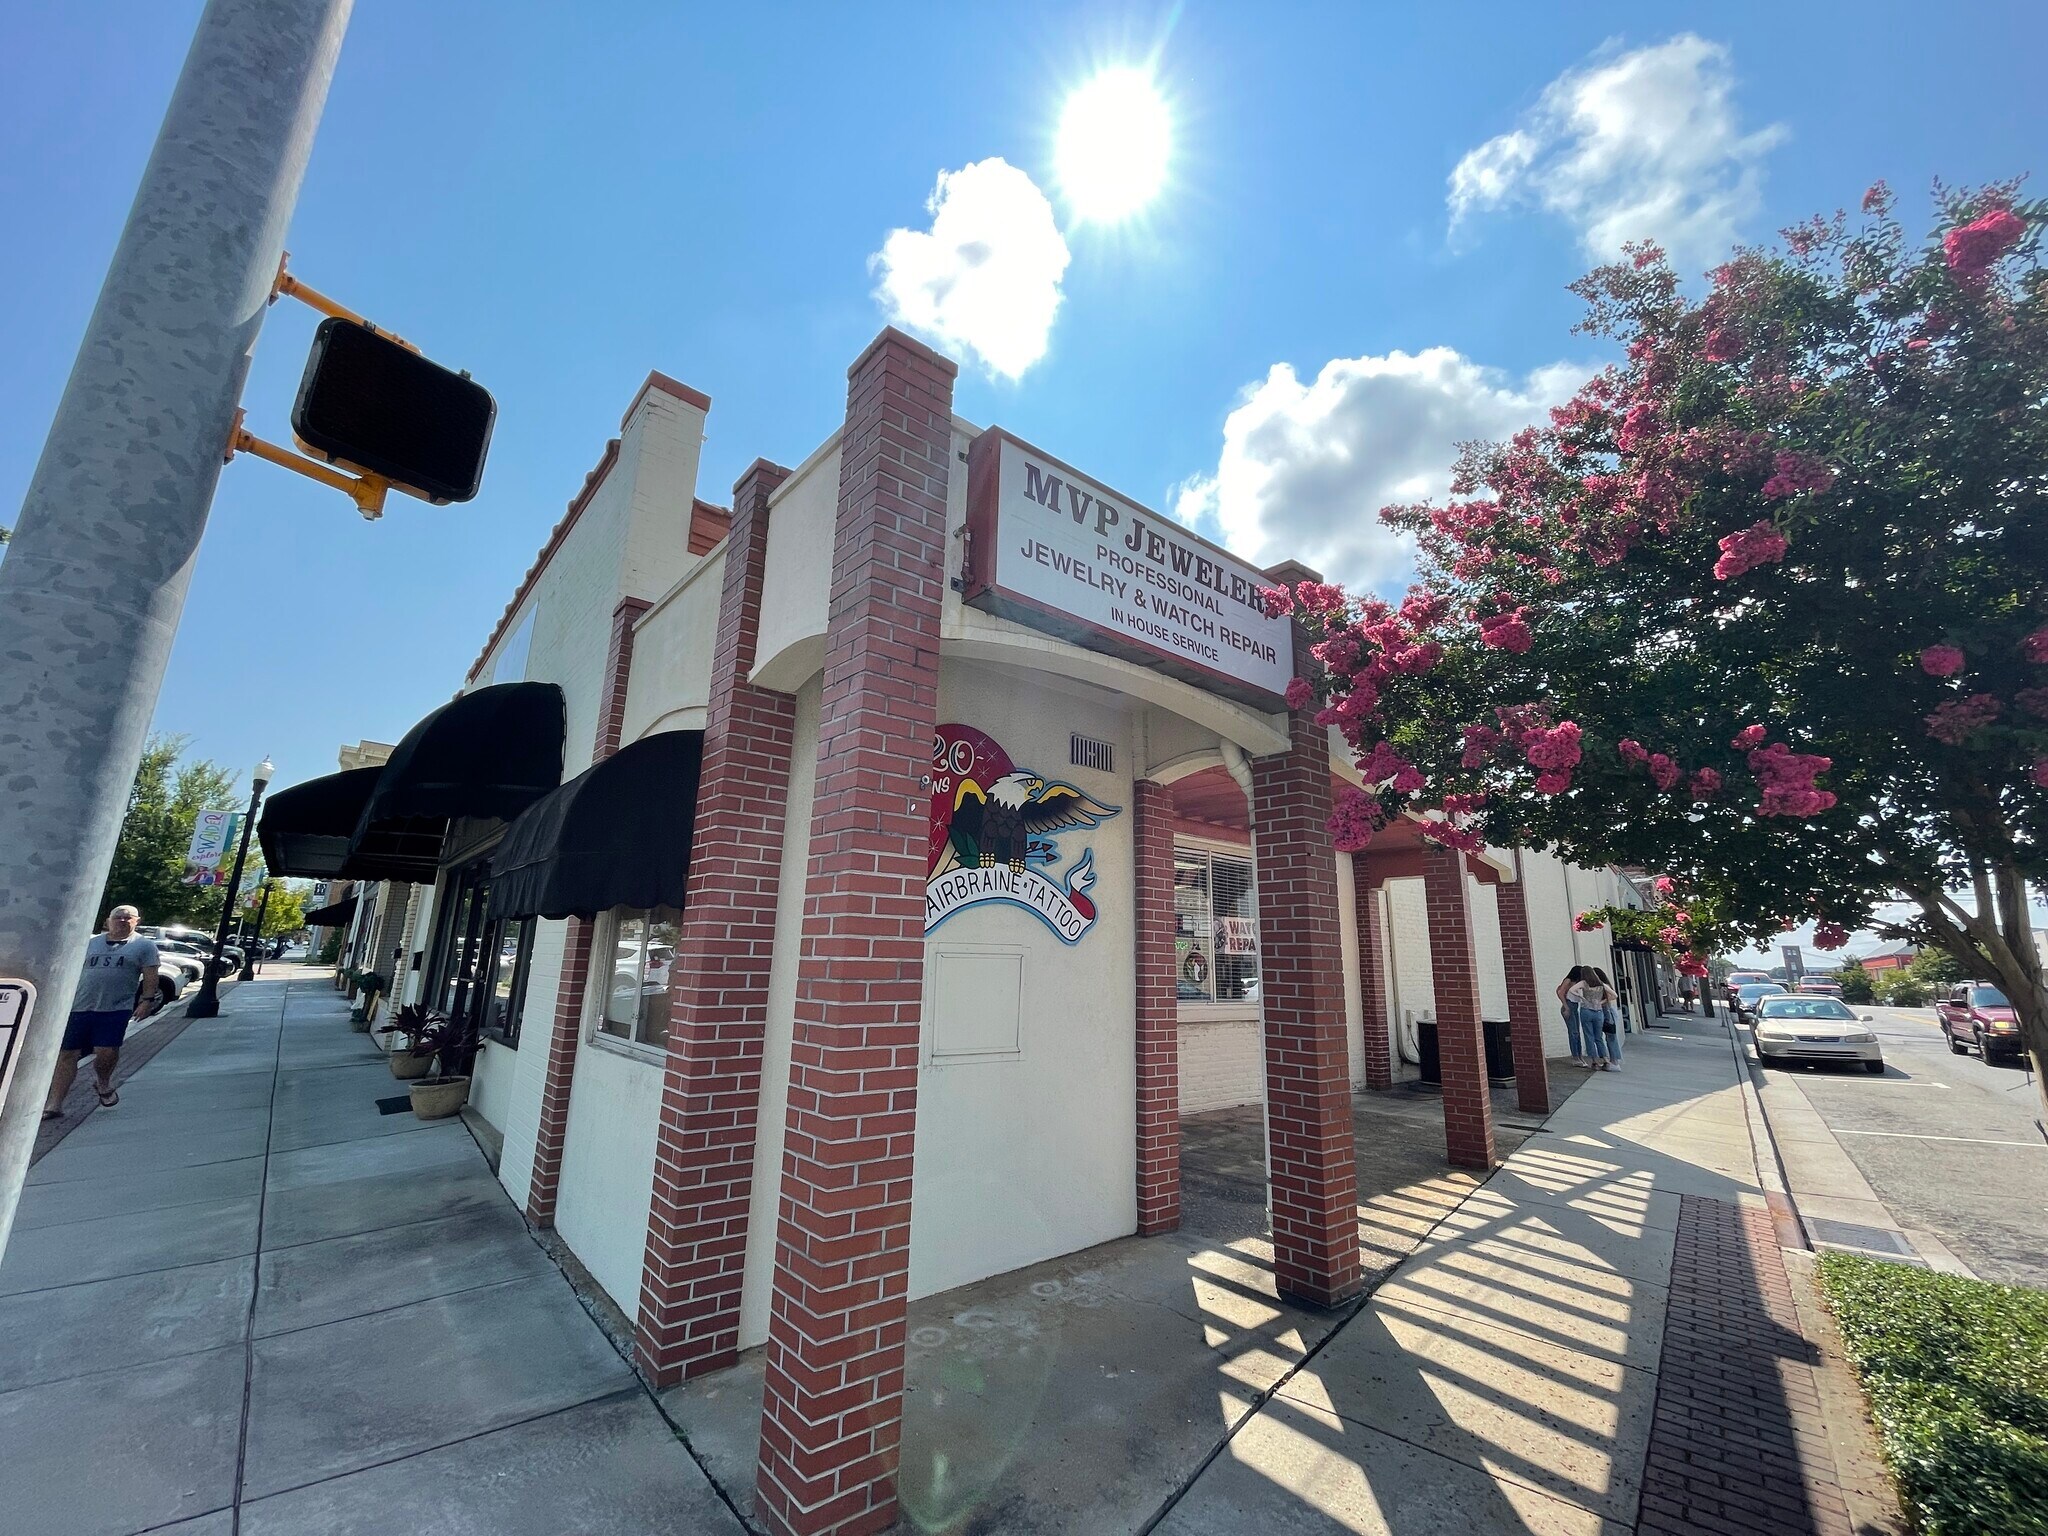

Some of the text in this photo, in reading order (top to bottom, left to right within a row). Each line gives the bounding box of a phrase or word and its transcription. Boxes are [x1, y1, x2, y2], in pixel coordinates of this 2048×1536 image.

[1023, 461, 1279, 620] MVP JEWELER
[1020, 538, 1277, 665] JEWELRY & WATCH REPAIR
[1096, 543, 1224, 617] PROFESSIONAL
[1111, 607, 1219, 663] IN HOUSE SERVICE
[924, 870, 1081, 937] AIRBRAINE TATTOO
